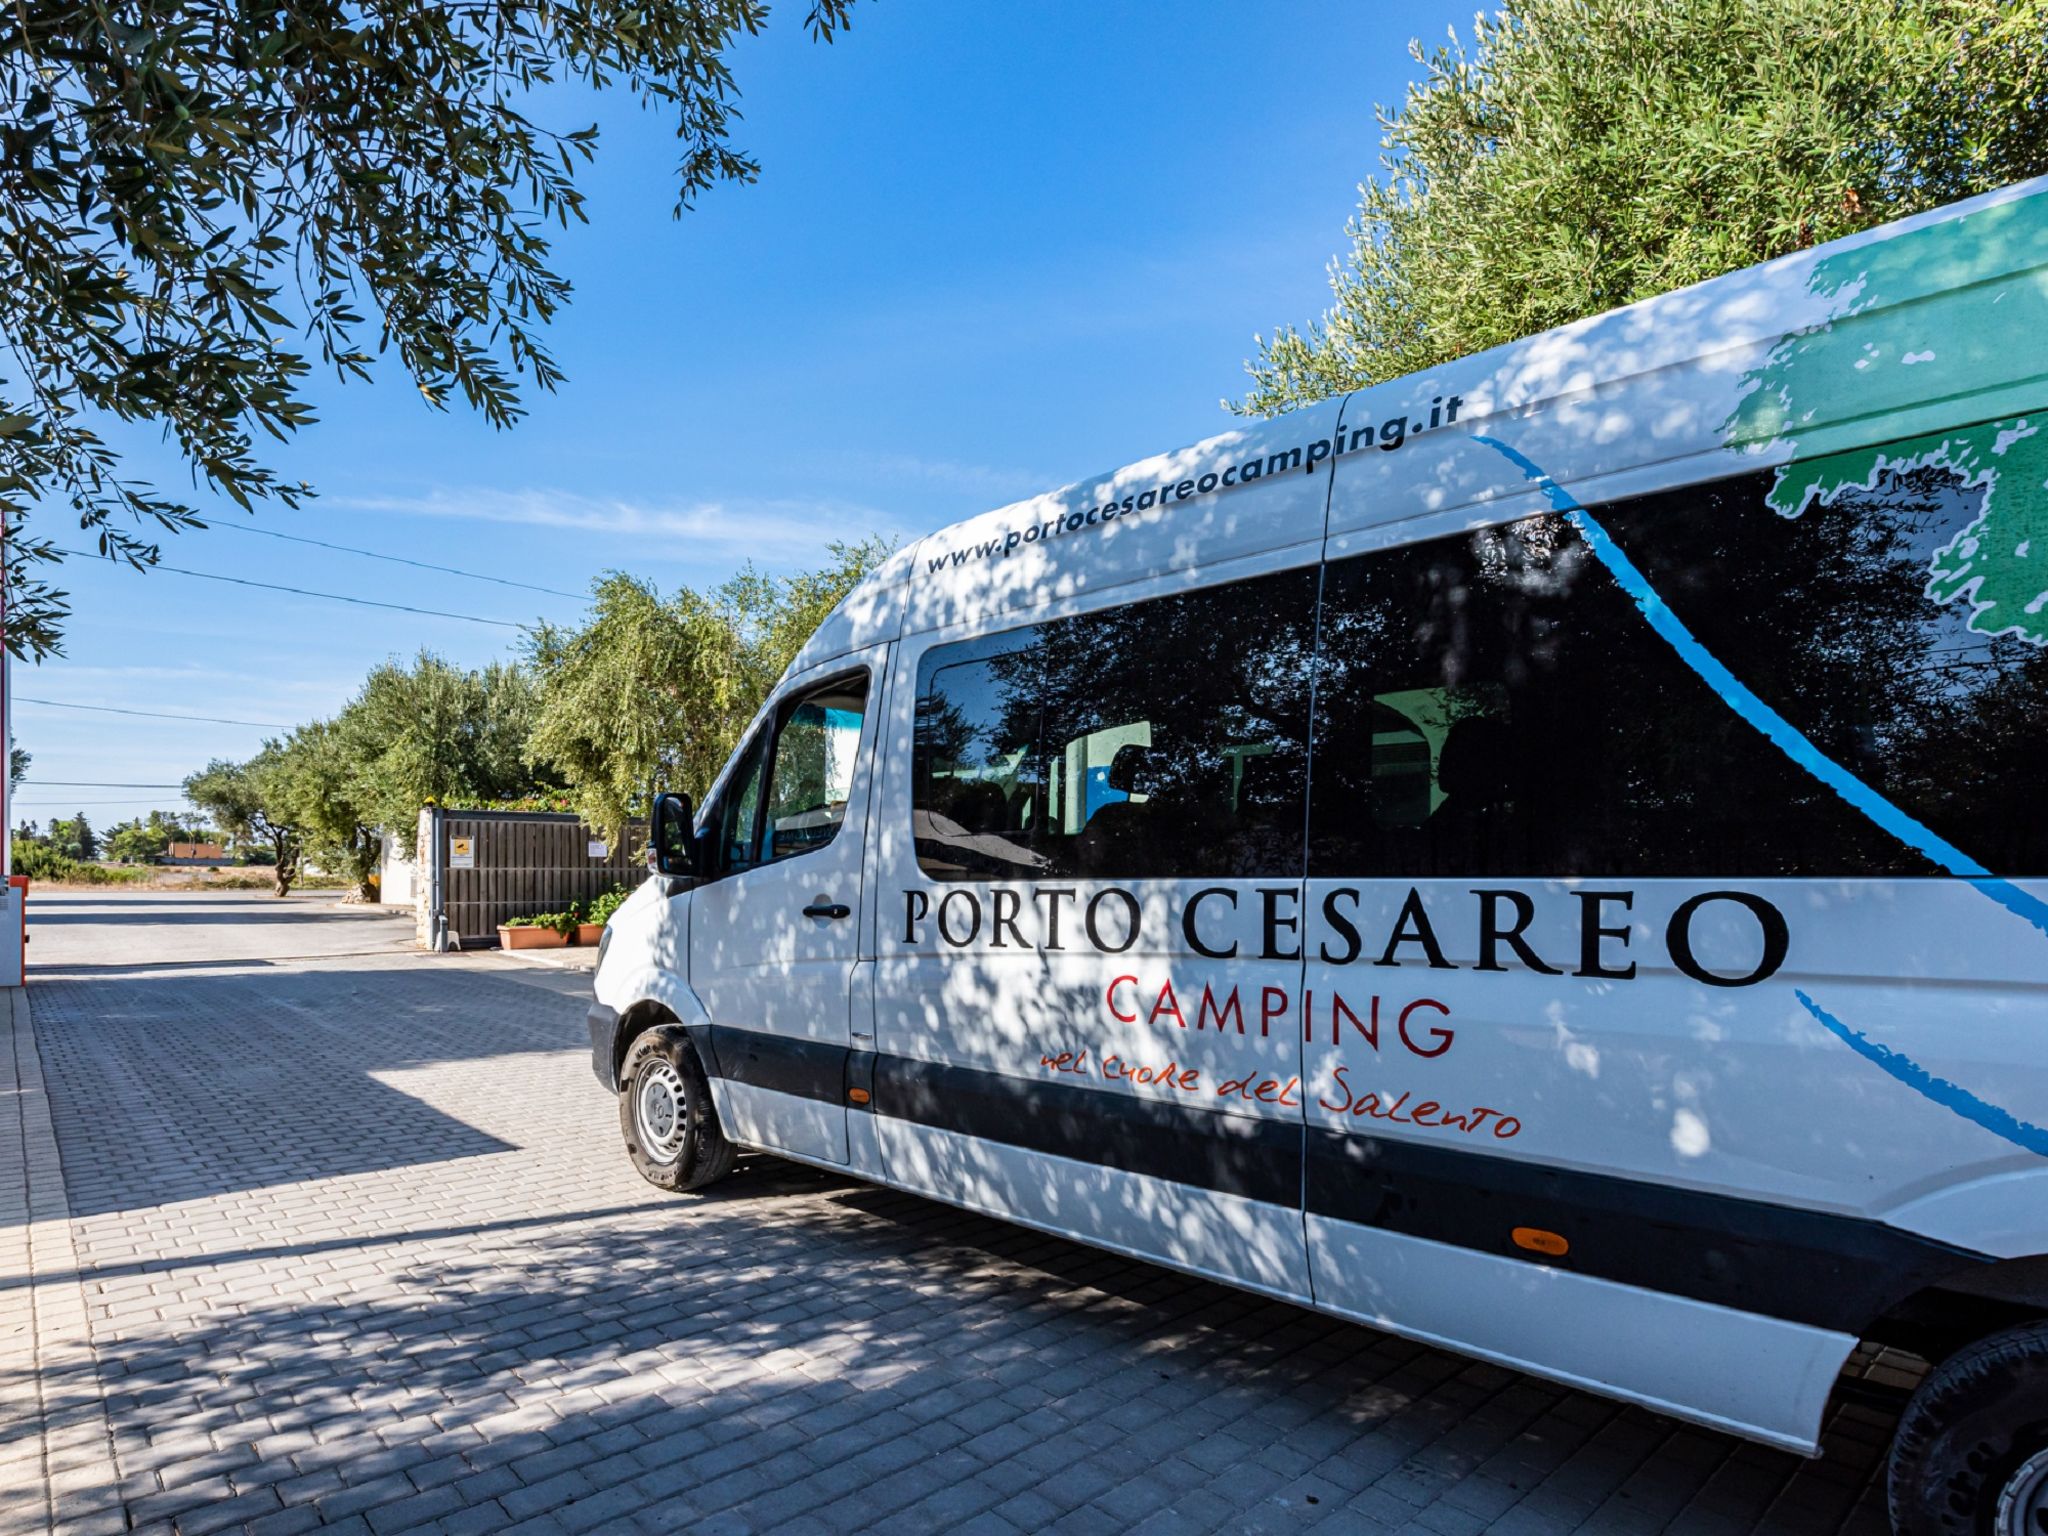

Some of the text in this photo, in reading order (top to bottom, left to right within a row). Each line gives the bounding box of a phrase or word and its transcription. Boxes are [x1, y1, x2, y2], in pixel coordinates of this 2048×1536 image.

[927, 395, 1464, 574] www.portocesareocamping.it
[902, 887, 1789, 987] PORTO CESAREO
[1106, 974, 1455, 1059] CAMPING
[1217, 1071, 1300, 1107] del
